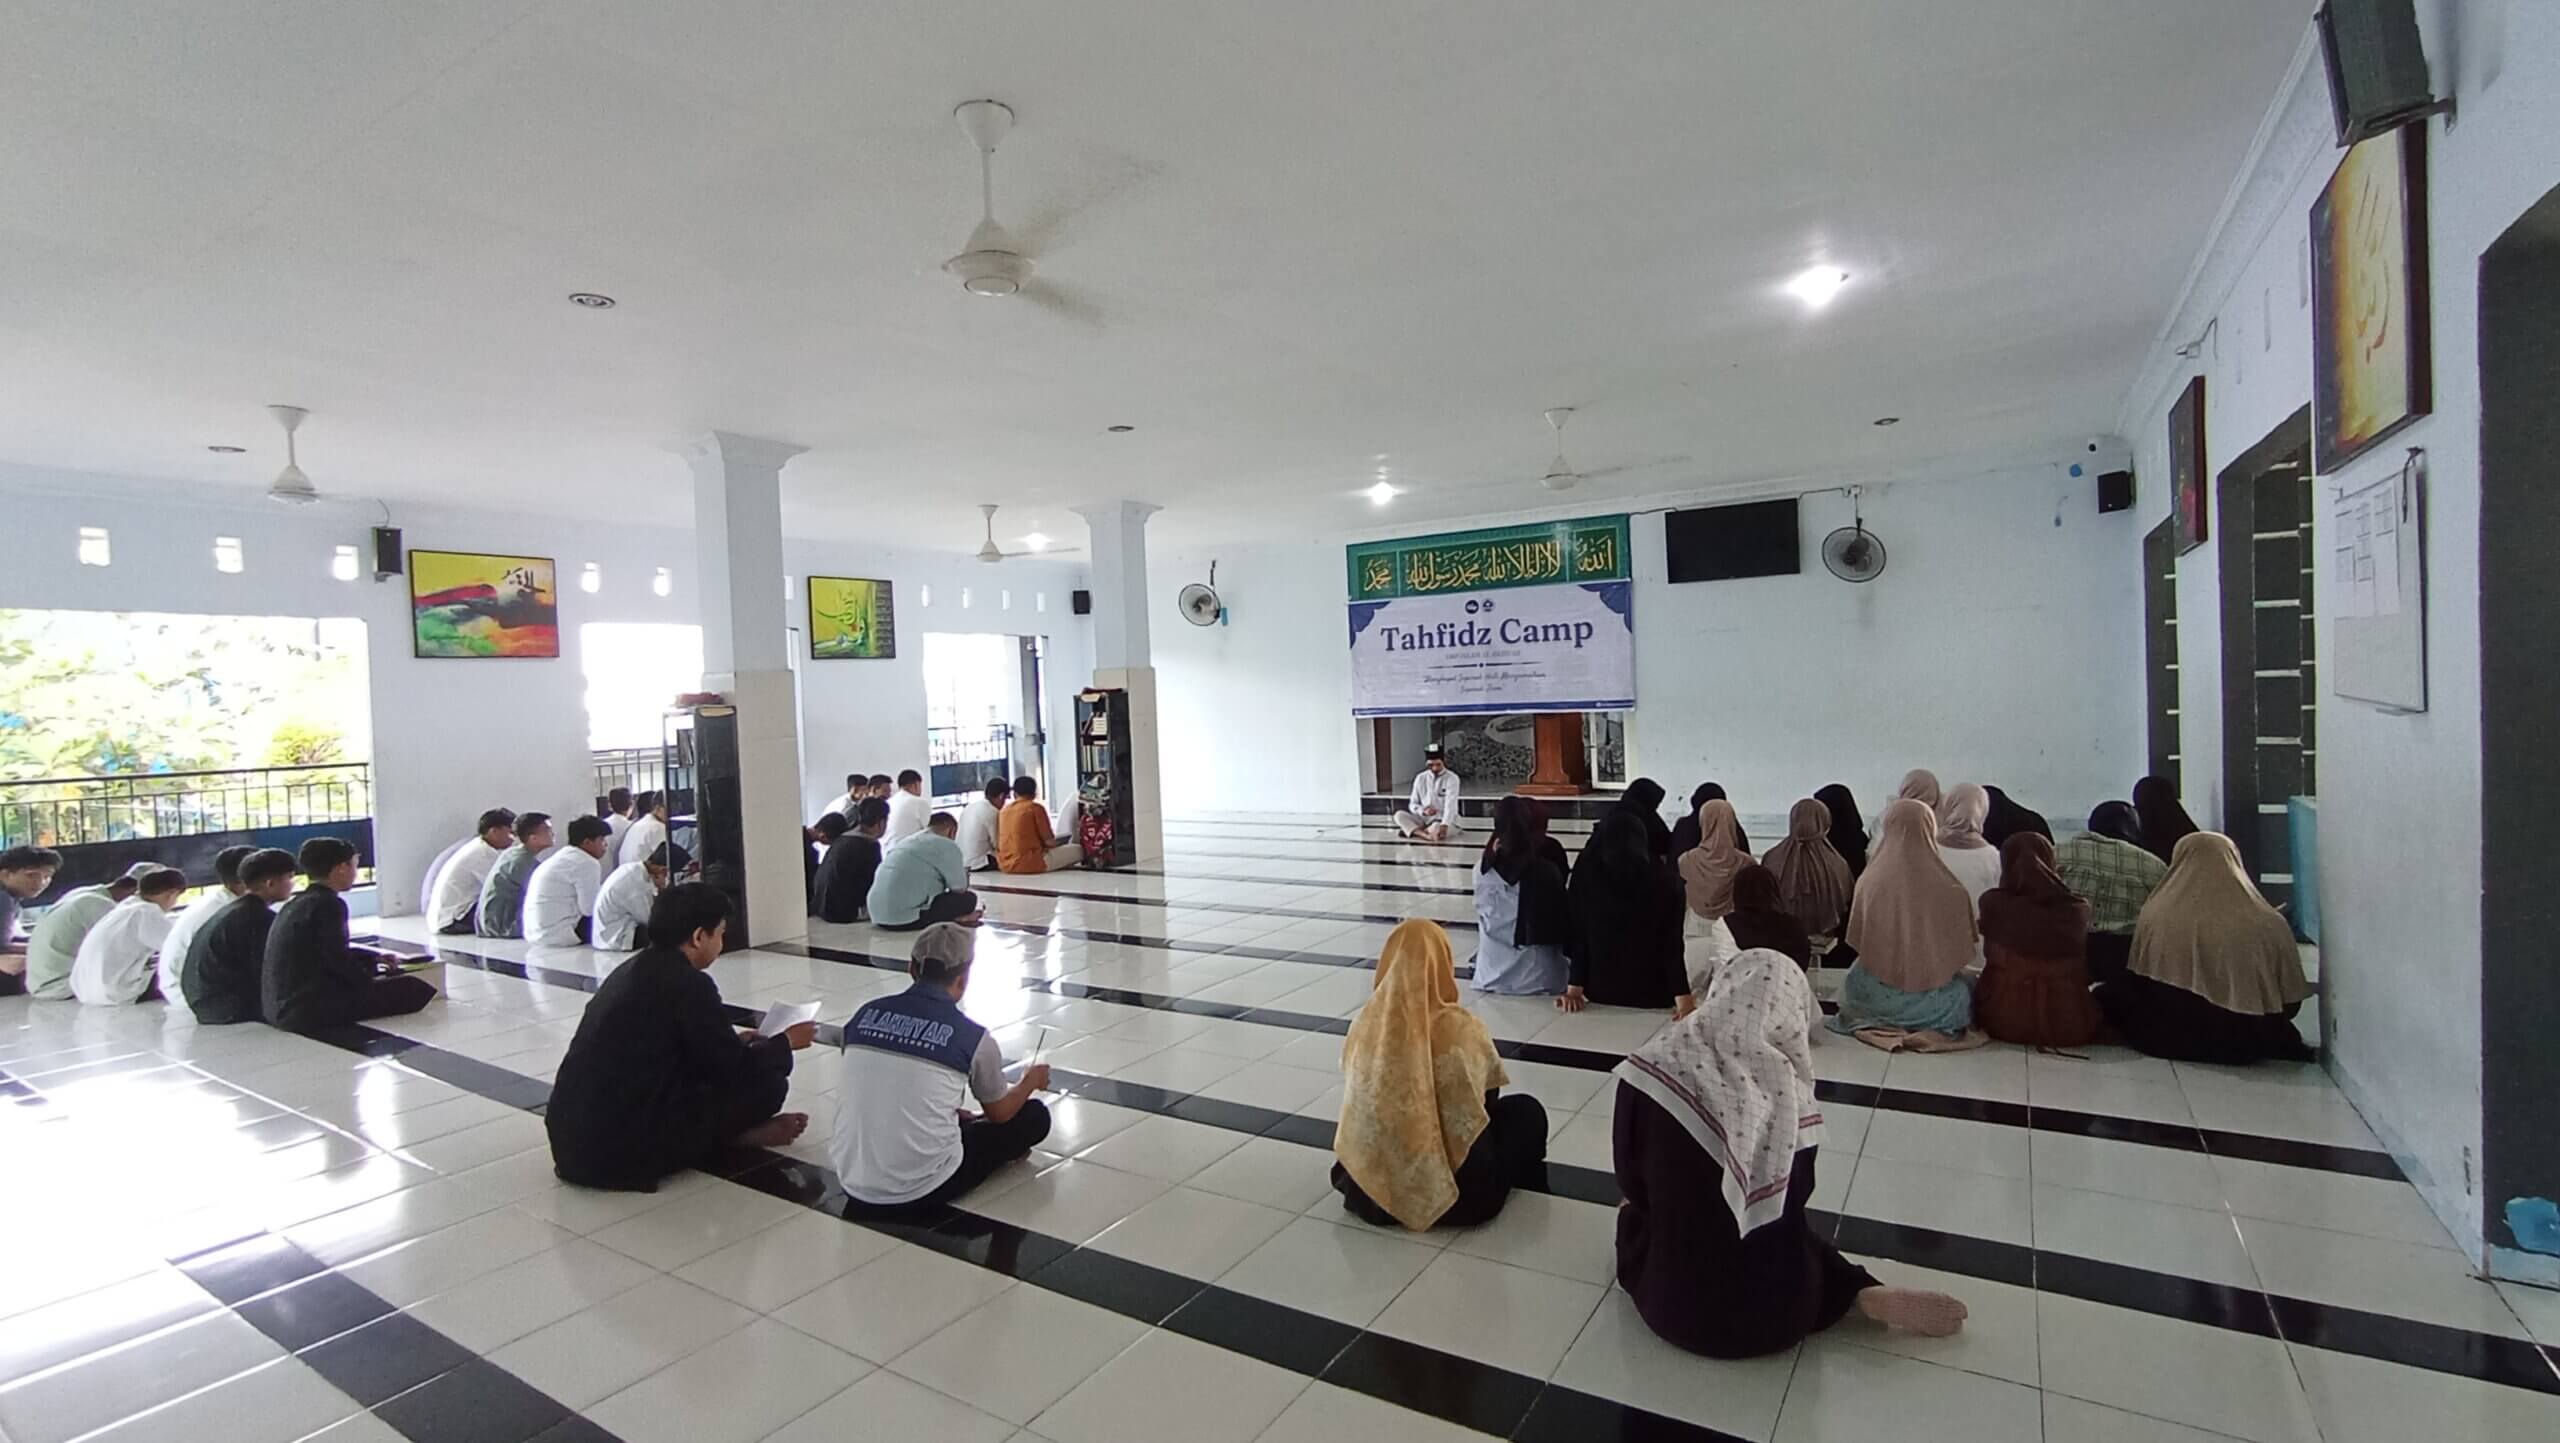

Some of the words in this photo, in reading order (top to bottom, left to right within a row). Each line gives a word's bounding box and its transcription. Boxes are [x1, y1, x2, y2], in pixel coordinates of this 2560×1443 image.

[1380, 619, 1491, 651] Tahfidz
[1500, 618, 1593, 648] Camp
[857, 1008, 954, 1047] ALAKHYAR
[898, 1037, 936, 1051] SCHOOL
